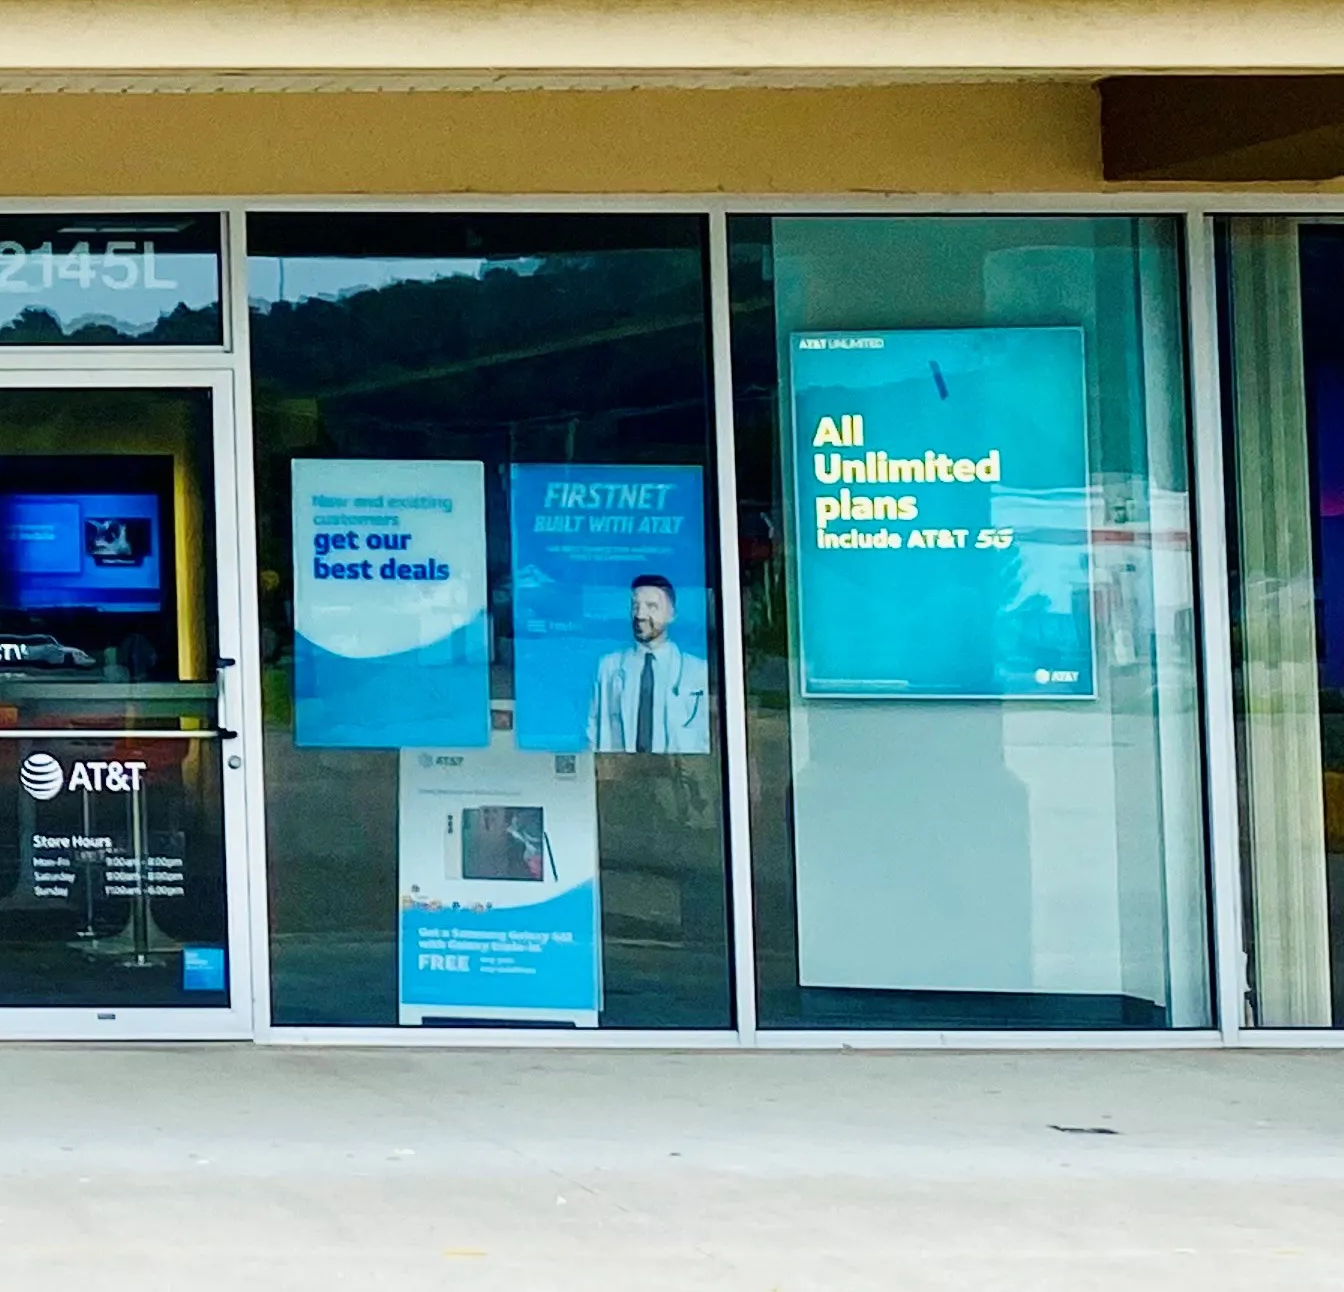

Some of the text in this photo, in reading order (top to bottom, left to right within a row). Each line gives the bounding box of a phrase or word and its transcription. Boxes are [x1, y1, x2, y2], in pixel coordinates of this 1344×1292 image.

[813, 414, 864, 447] All
[814, 450, 1001, 484] Unlimited
[544, 481, 678, 510] FIRSTNET
[815, 487, 919, 528] plans
[533, 515, 685, 534] BUILT WITH AT&T
[314, 530, 412, 555] get our
[907, 529, 969, 549] AT&T
[974, 528, 1014, 549] 5G
[314, 557, 450, 580] best deals
[68, 761, 147, 792] AT&T
[33, 834, 112, 848] Store Hours
[418, 954, 470, 973] FREE
